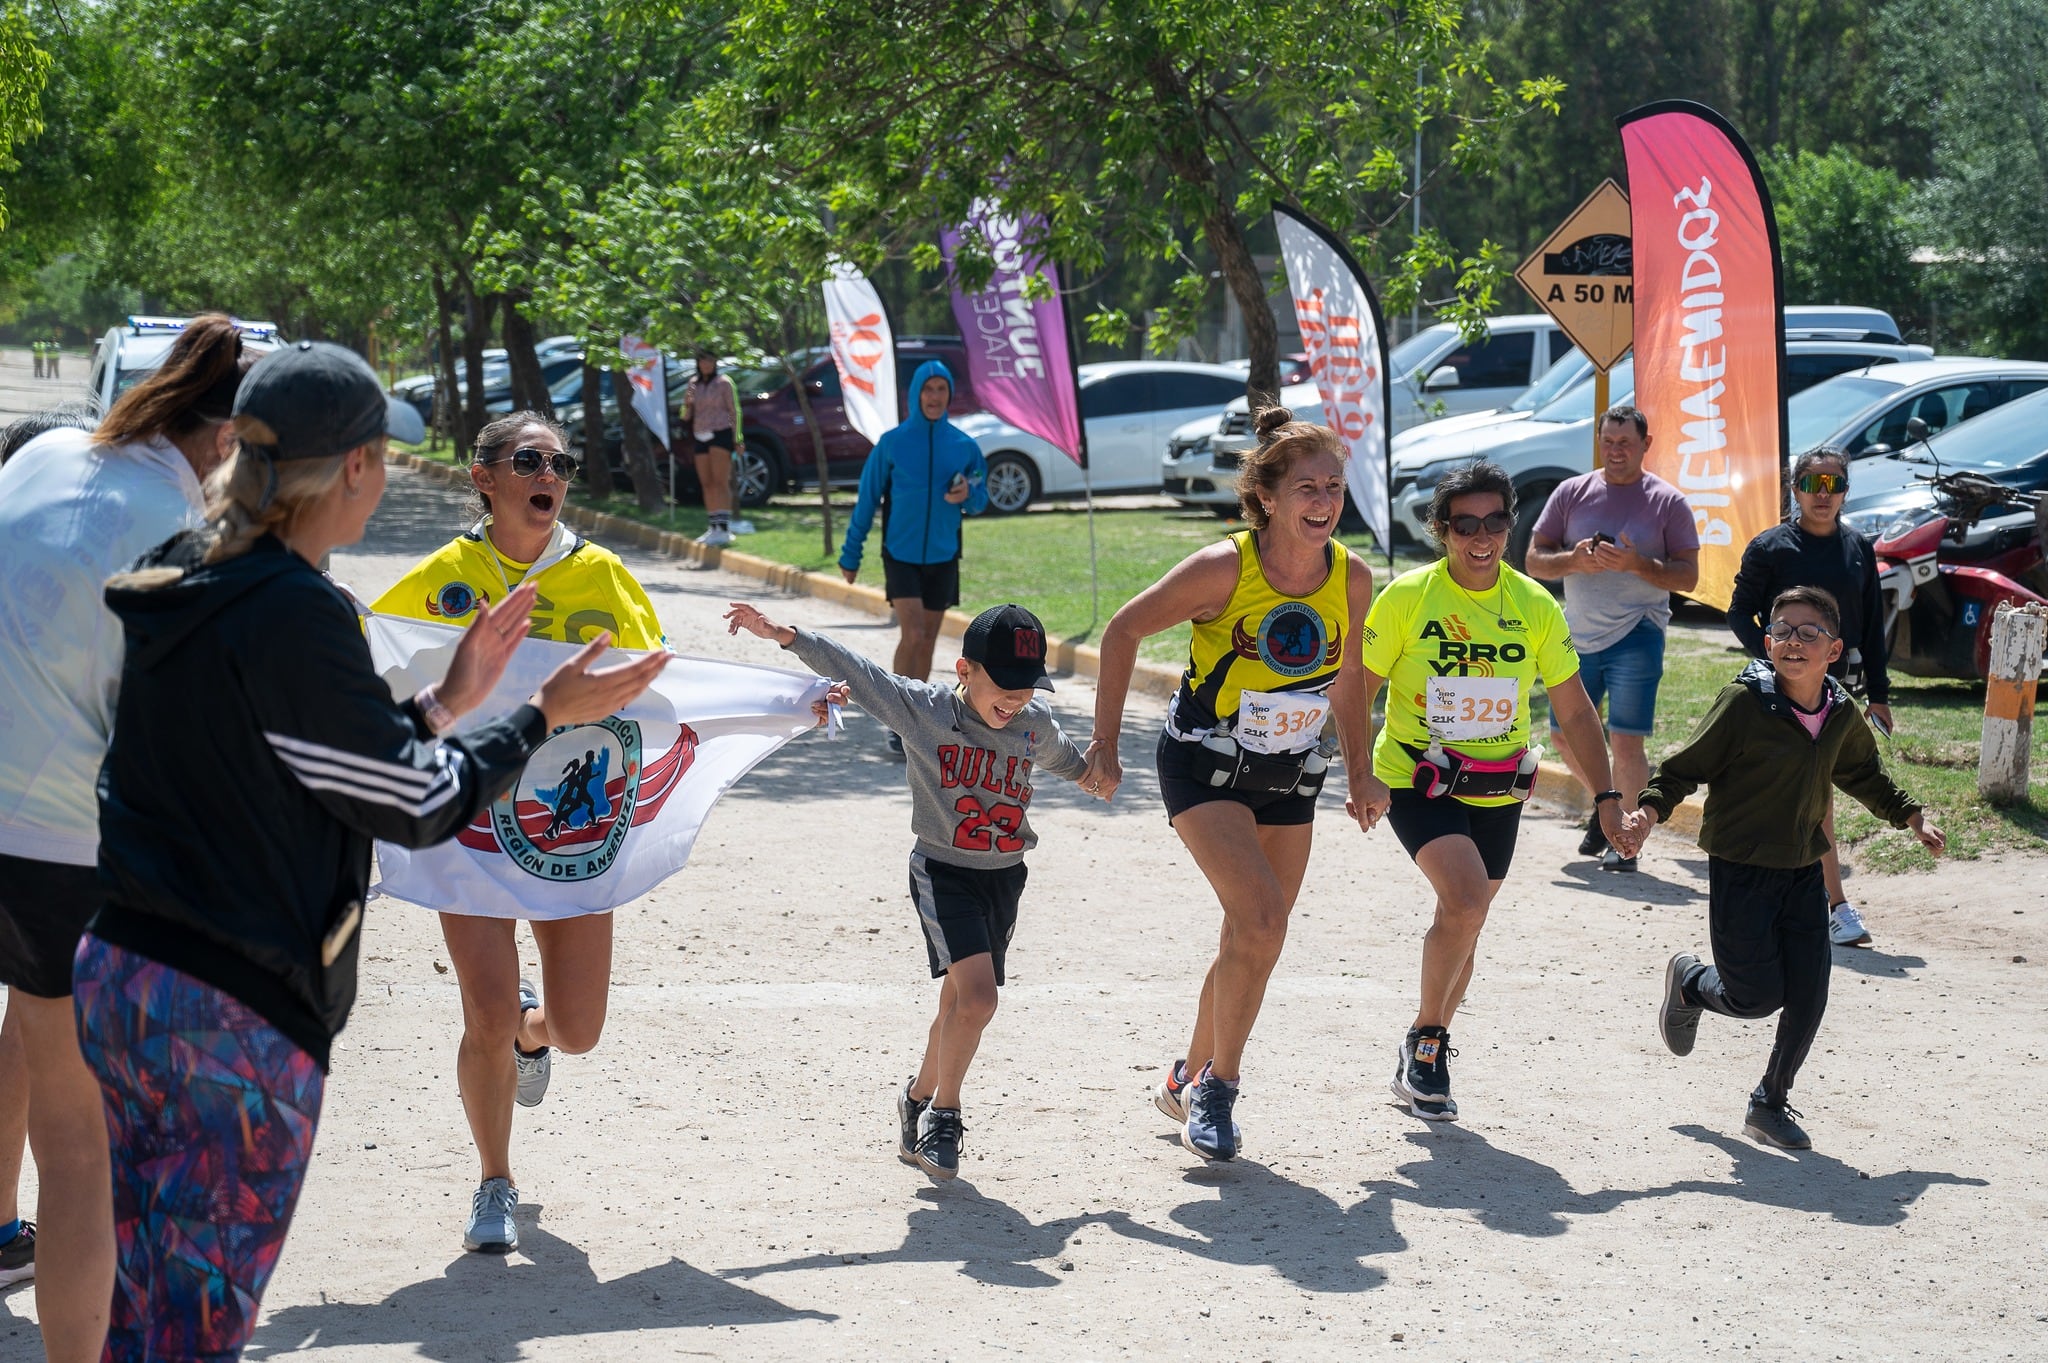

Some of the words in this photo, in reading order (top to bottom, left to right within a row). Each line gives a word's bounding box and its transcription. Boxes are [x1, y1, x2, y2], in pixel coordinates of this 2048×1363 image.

[1547, 284, 1565, 302] A
[1574, 284, 1604, 303] 50
[1271, 604, 1292, 619] GRUPO
[1419, 620, 1448, 639] A
[1439, 641, 1526, 663] RRO
[1292, 658, 1322, 675] ANSENUZA
[1431, 715, 1456, 723] 21K
[1460, 697, 1513, 723] 329
[1273, 708, 1321, 737] 330
[1243, 728, 1268, 738] 21K
[937, 744, 1034, 804] BULLS
[550, 863, 577, 877] DE
[586, 787, 635, 875] ANSENUZA
[952, 794, 1026, 853] 23
